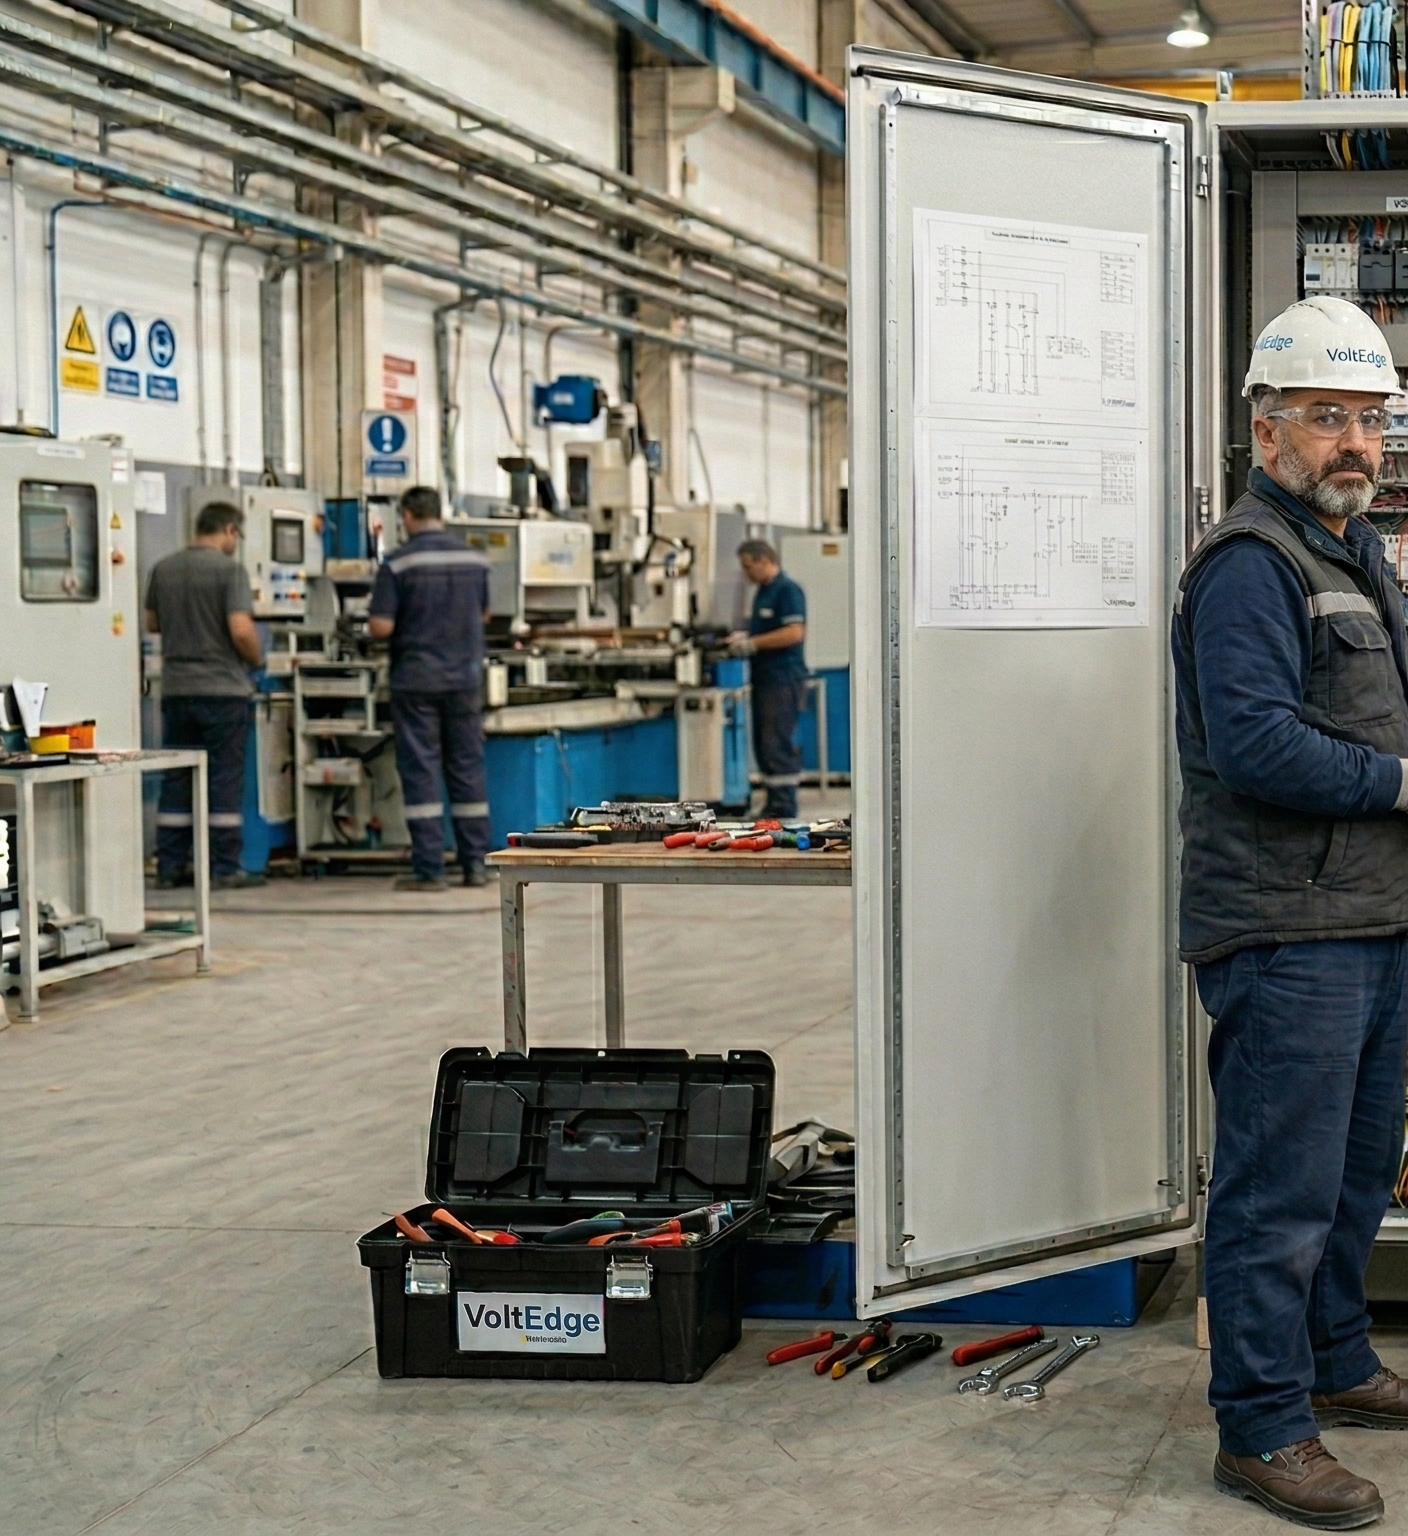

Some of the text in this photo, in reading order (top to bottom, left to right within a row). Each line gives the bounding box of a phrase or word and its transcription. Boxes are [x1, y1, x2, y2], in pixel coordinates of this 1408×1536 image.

[1256, 334, 1293, 351] Edge
[1326, 347, 1387, 368] VoltEdge
[463, 1303, 600, 1337] VoltEdge
